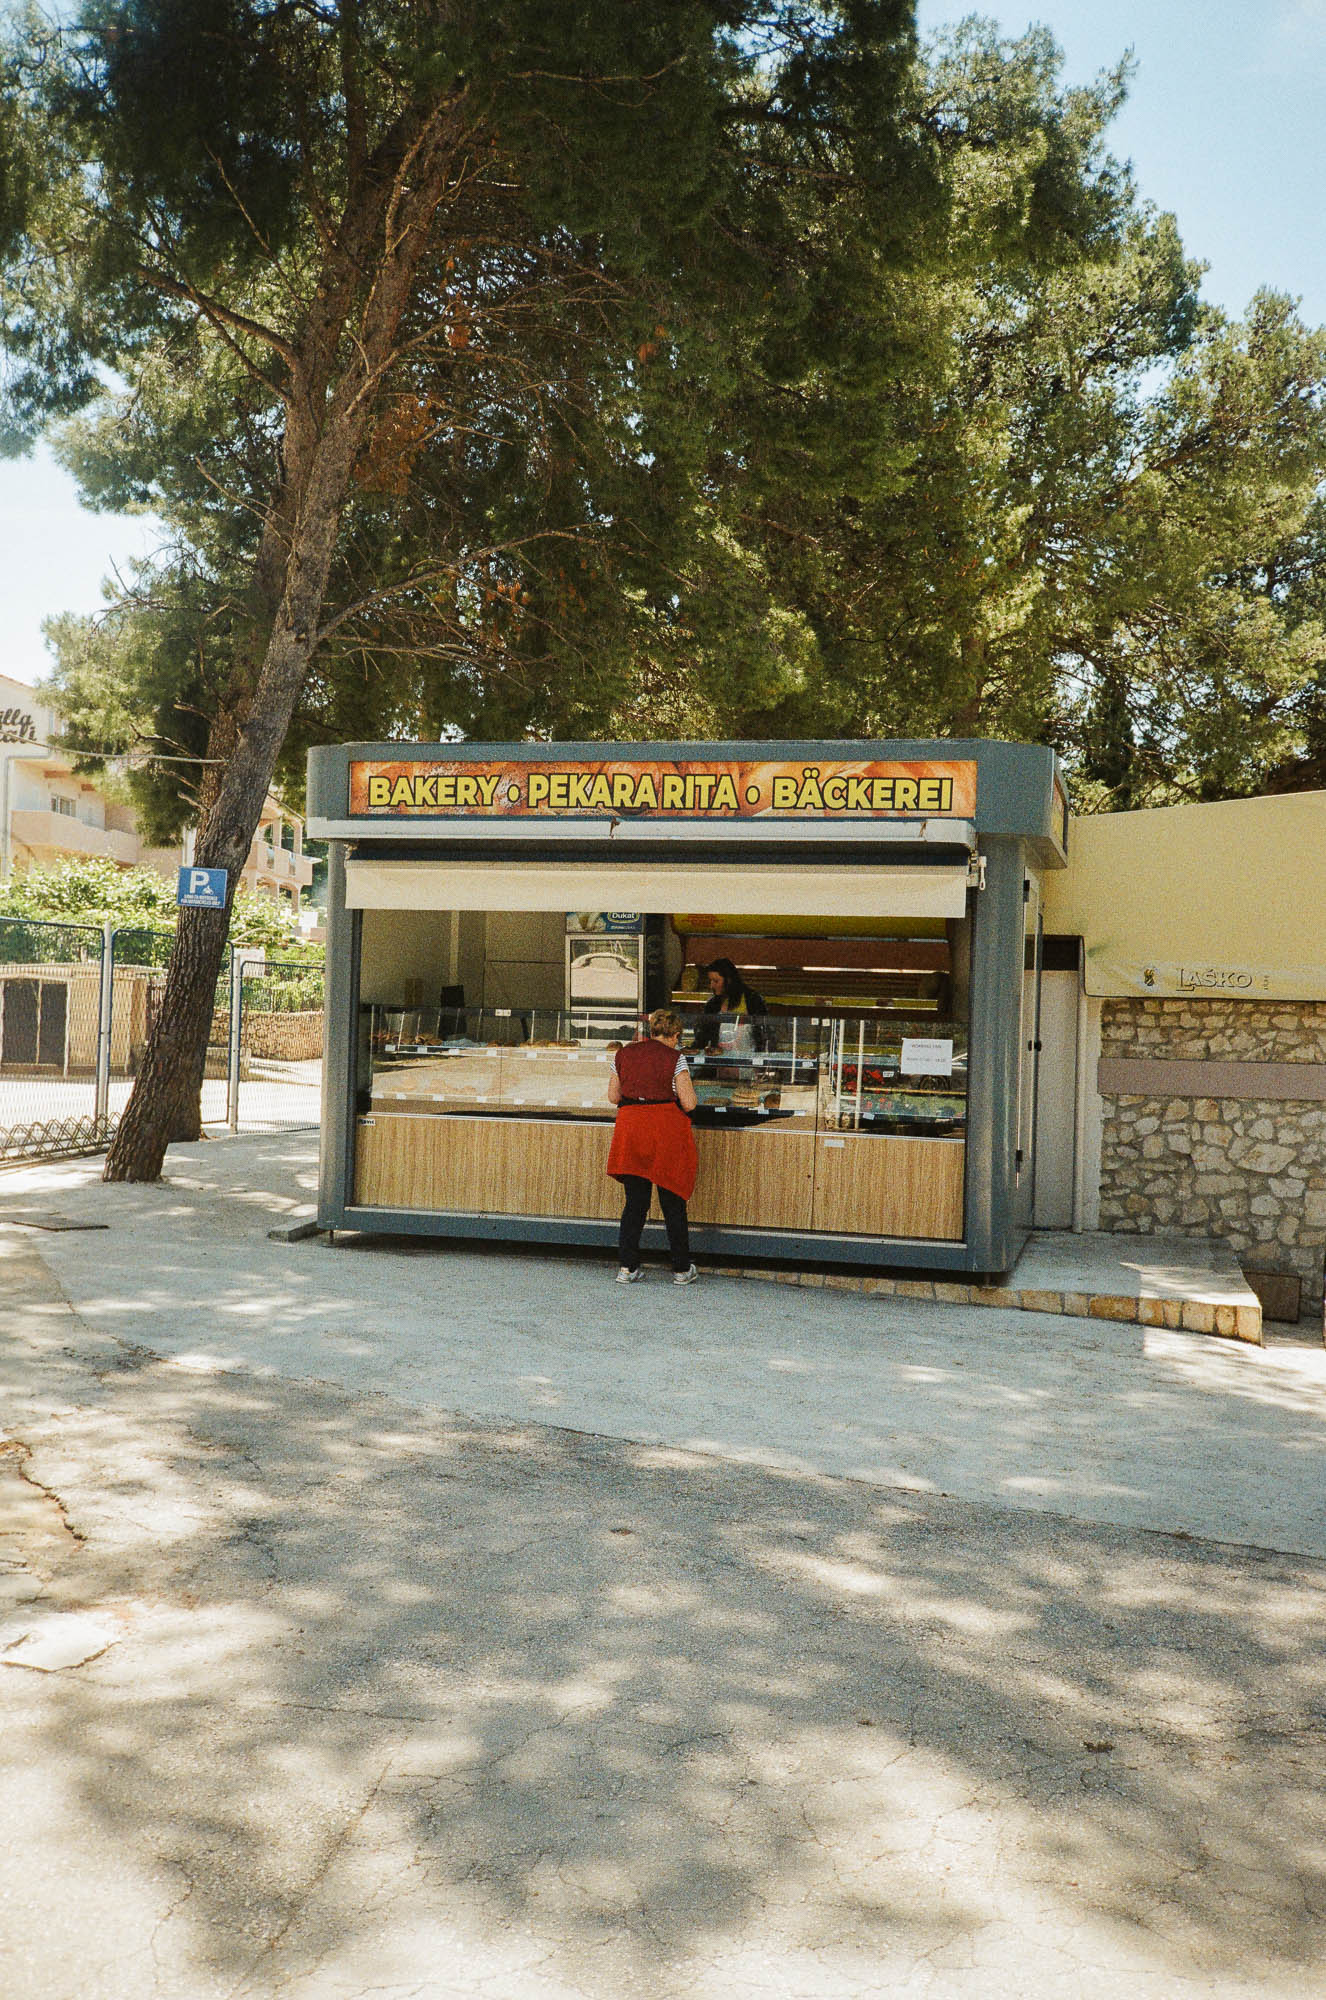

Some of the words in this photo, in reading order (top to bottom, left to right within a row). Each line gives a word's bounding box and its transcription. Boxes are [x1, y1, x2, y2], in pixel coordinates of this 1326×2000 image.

[368, 775, 501, 807] BAKERY
[527, 773, 658, 808] PEKARA
[661, 774, 740, 810] RITA
[772, 768, 954, 811] BÄCKEREI
[190, 870, 210, 894] P
